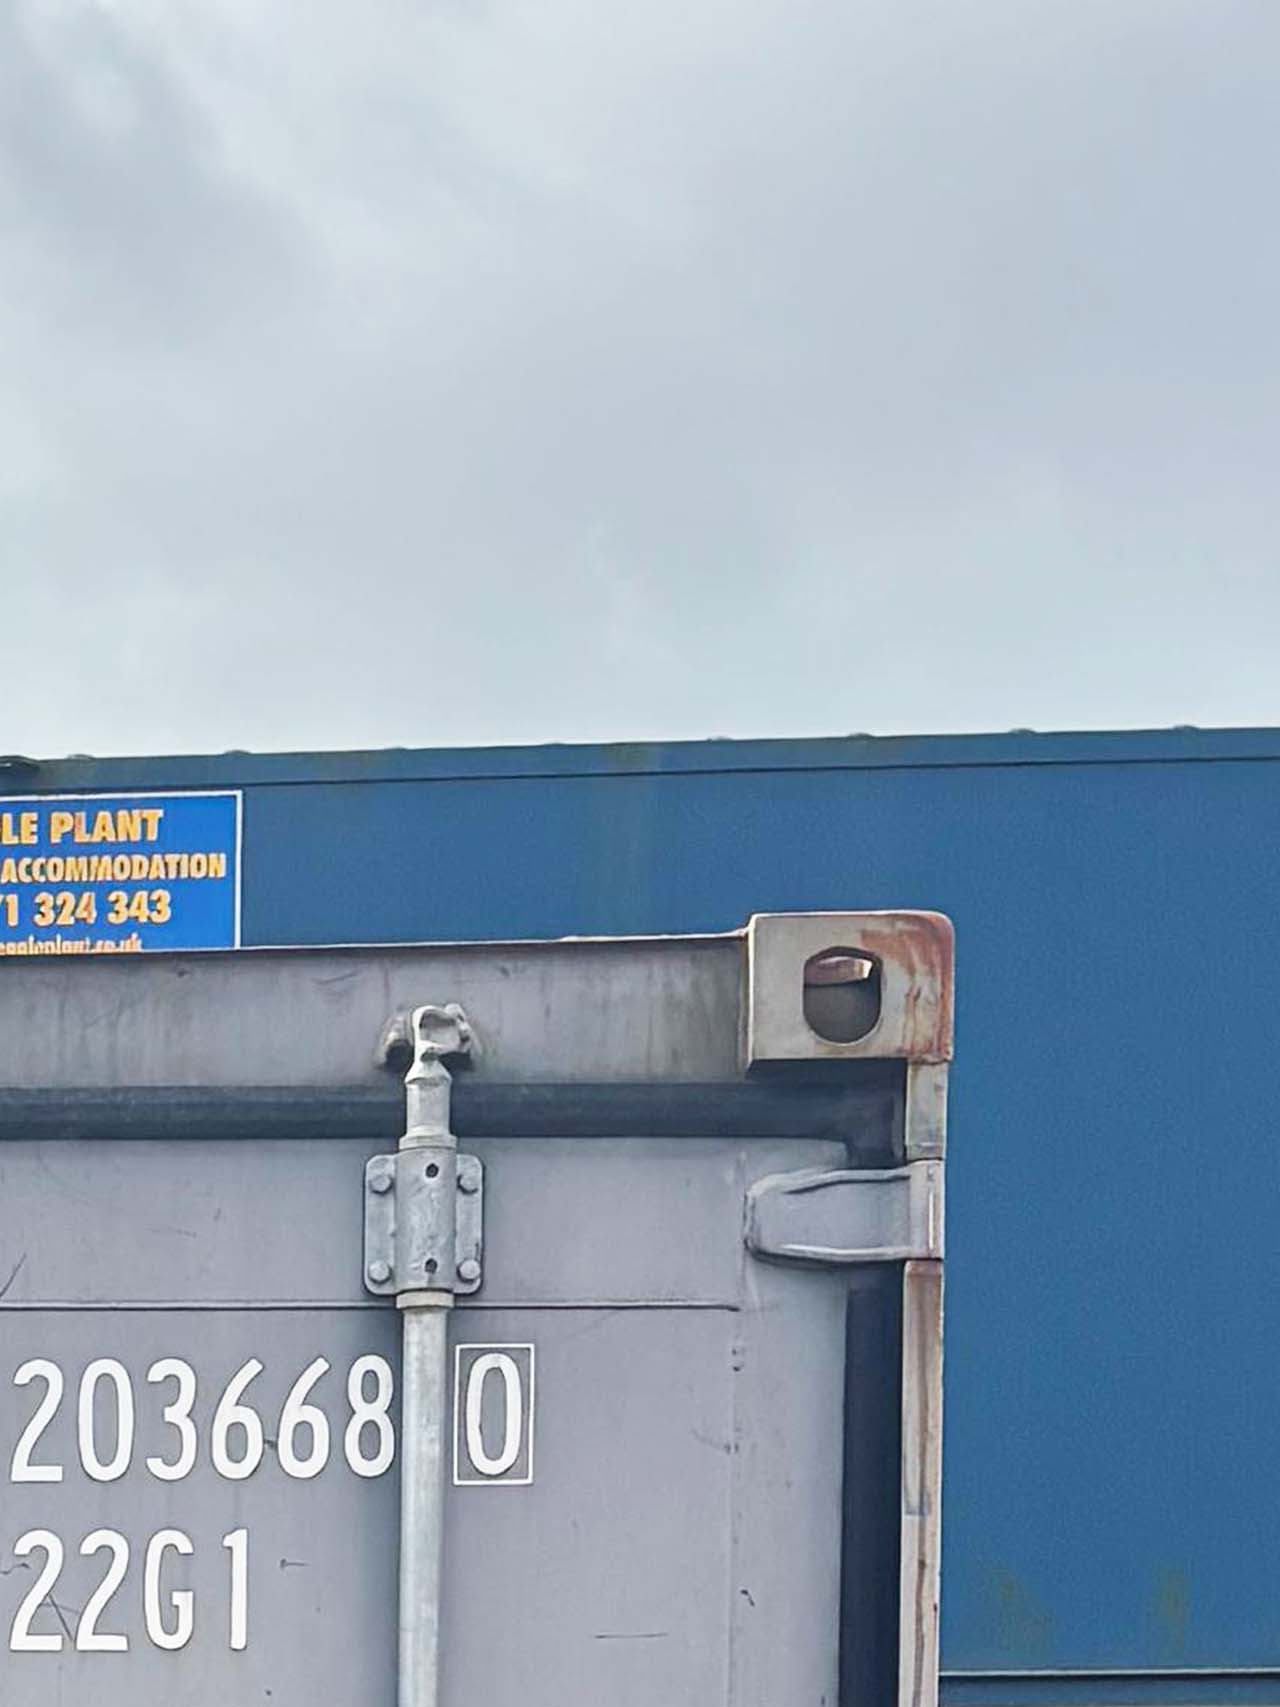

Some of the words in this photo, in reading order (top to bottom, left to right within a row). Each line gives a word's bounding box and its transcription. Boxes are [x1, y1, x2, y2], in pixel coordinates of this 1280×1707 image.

[50, 809, 164, 843] PLANT
[0, 853, 227, 885] ACCOMMODATION
[33, 892, 98, 927] 324
[107, 889, 172, 924] 343
[10, 1354, 395, 1482] 203668
[465, 1352, 521, 1476] 0
[9, 1527, 249, 1652] 22G1
